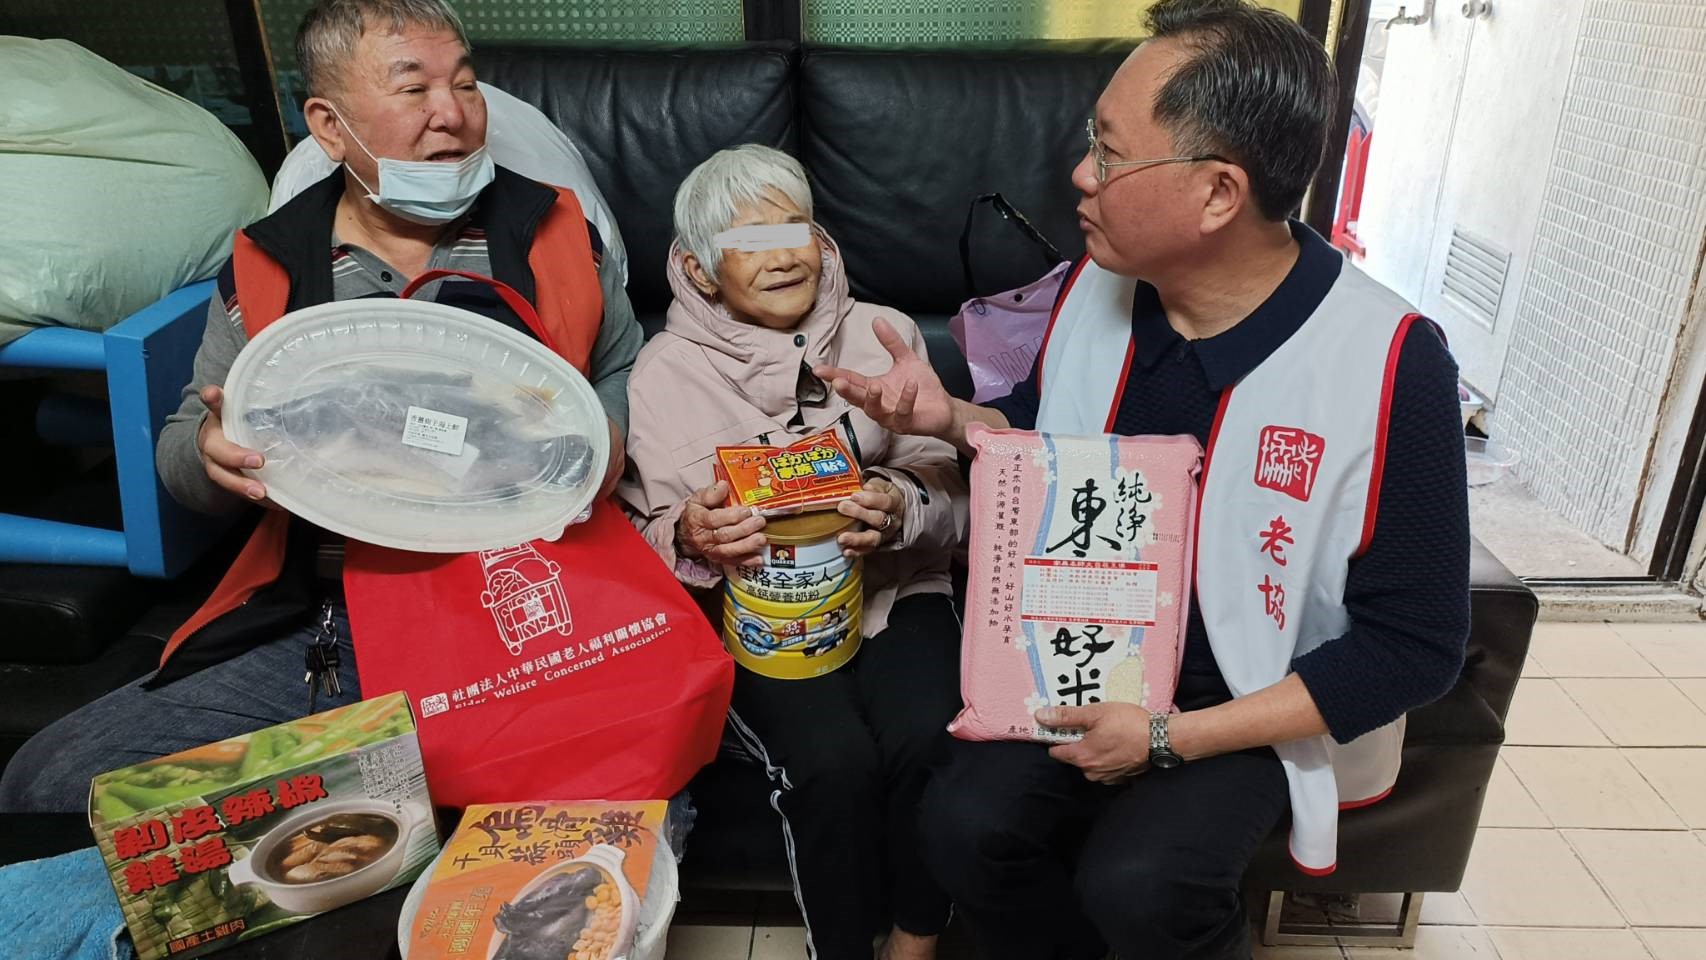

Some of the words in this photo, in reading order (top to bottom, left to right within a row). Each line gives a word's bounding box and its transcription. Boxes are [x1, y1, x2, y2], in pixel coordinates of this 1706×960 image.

[771, 447, 836, 468] ぽかぽか
[777, 464, 815, 479] 家族
[1114, 472, 1152, 542] 純淨
[737, 567, 833, 589] 佳格全家人
[1257, 515, 1294, 631] 老協
[452, 612, 668, 702] 社團法人中華民國老人福利關懷協會
[494, 678, 537, 699] Welfare
[544, 653, 605, 681] Concerned
[611, 626, 672, 656] Association
[114, 774, 328, 860] 剝皮辣椒
[123, 837, 233, 894] 雞湯
[169, 918, 246, 953] 國產土雞肉
